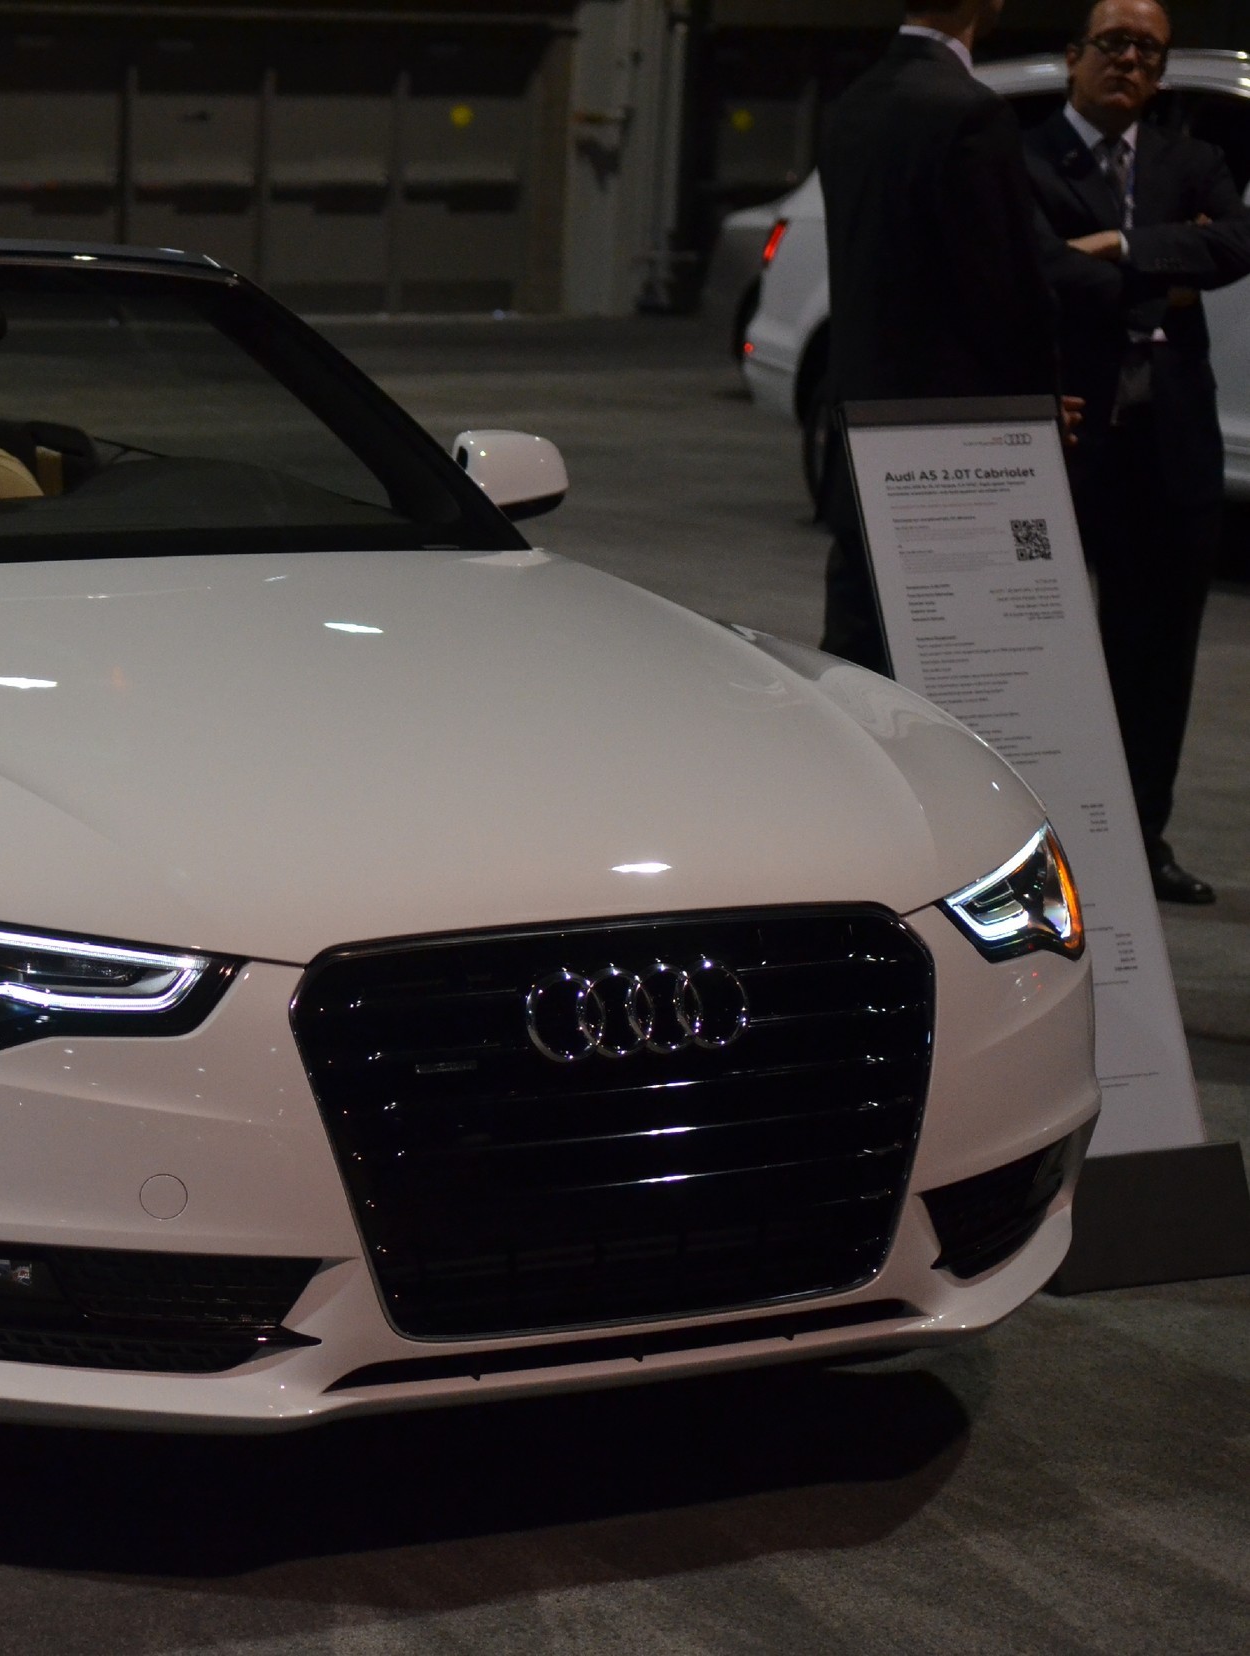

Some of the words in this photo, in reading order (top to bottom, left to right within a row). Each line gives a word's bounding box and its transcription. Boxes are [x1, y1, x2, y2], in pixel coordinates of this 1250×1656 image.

[885, 471, 916, 483] Audi
[920, 470, 938, 481] A5
[942, 469, 970, 480] 2.0T
[975, 467, 1035, 479] Cabriolet
